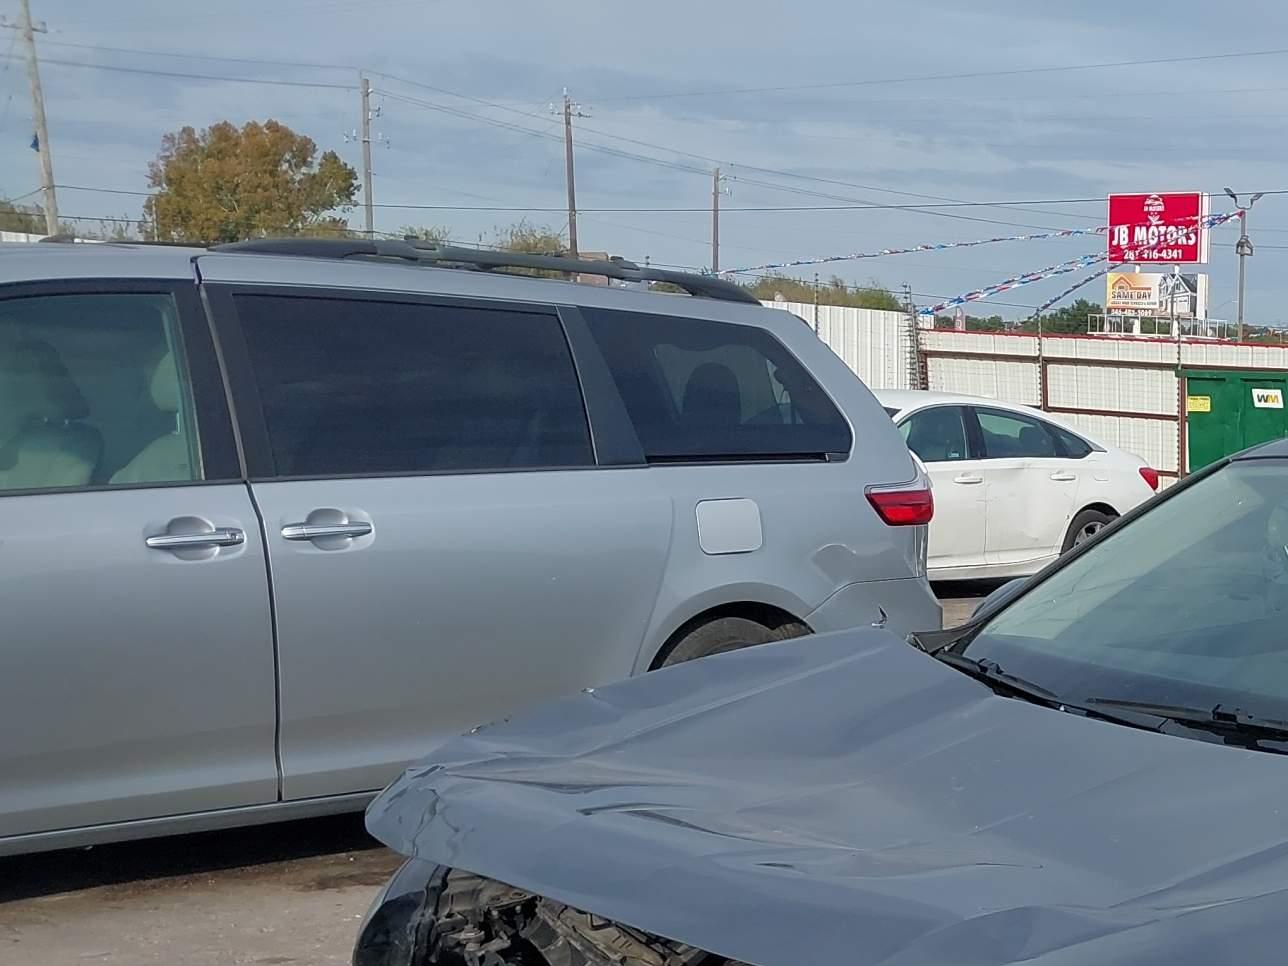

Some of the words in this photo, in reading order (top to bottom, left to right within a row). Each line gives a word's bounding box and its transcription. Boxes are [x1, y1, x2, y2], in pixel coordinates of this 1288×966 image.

[1112, 225, 1129, 246] JB
[1134, 226, 1196, 246] MOTORS
[1111, 291, 1133, 299] SAME
[1136, 291, 1152, 299] DAY
[1257, 394, 1278, 403] WM
